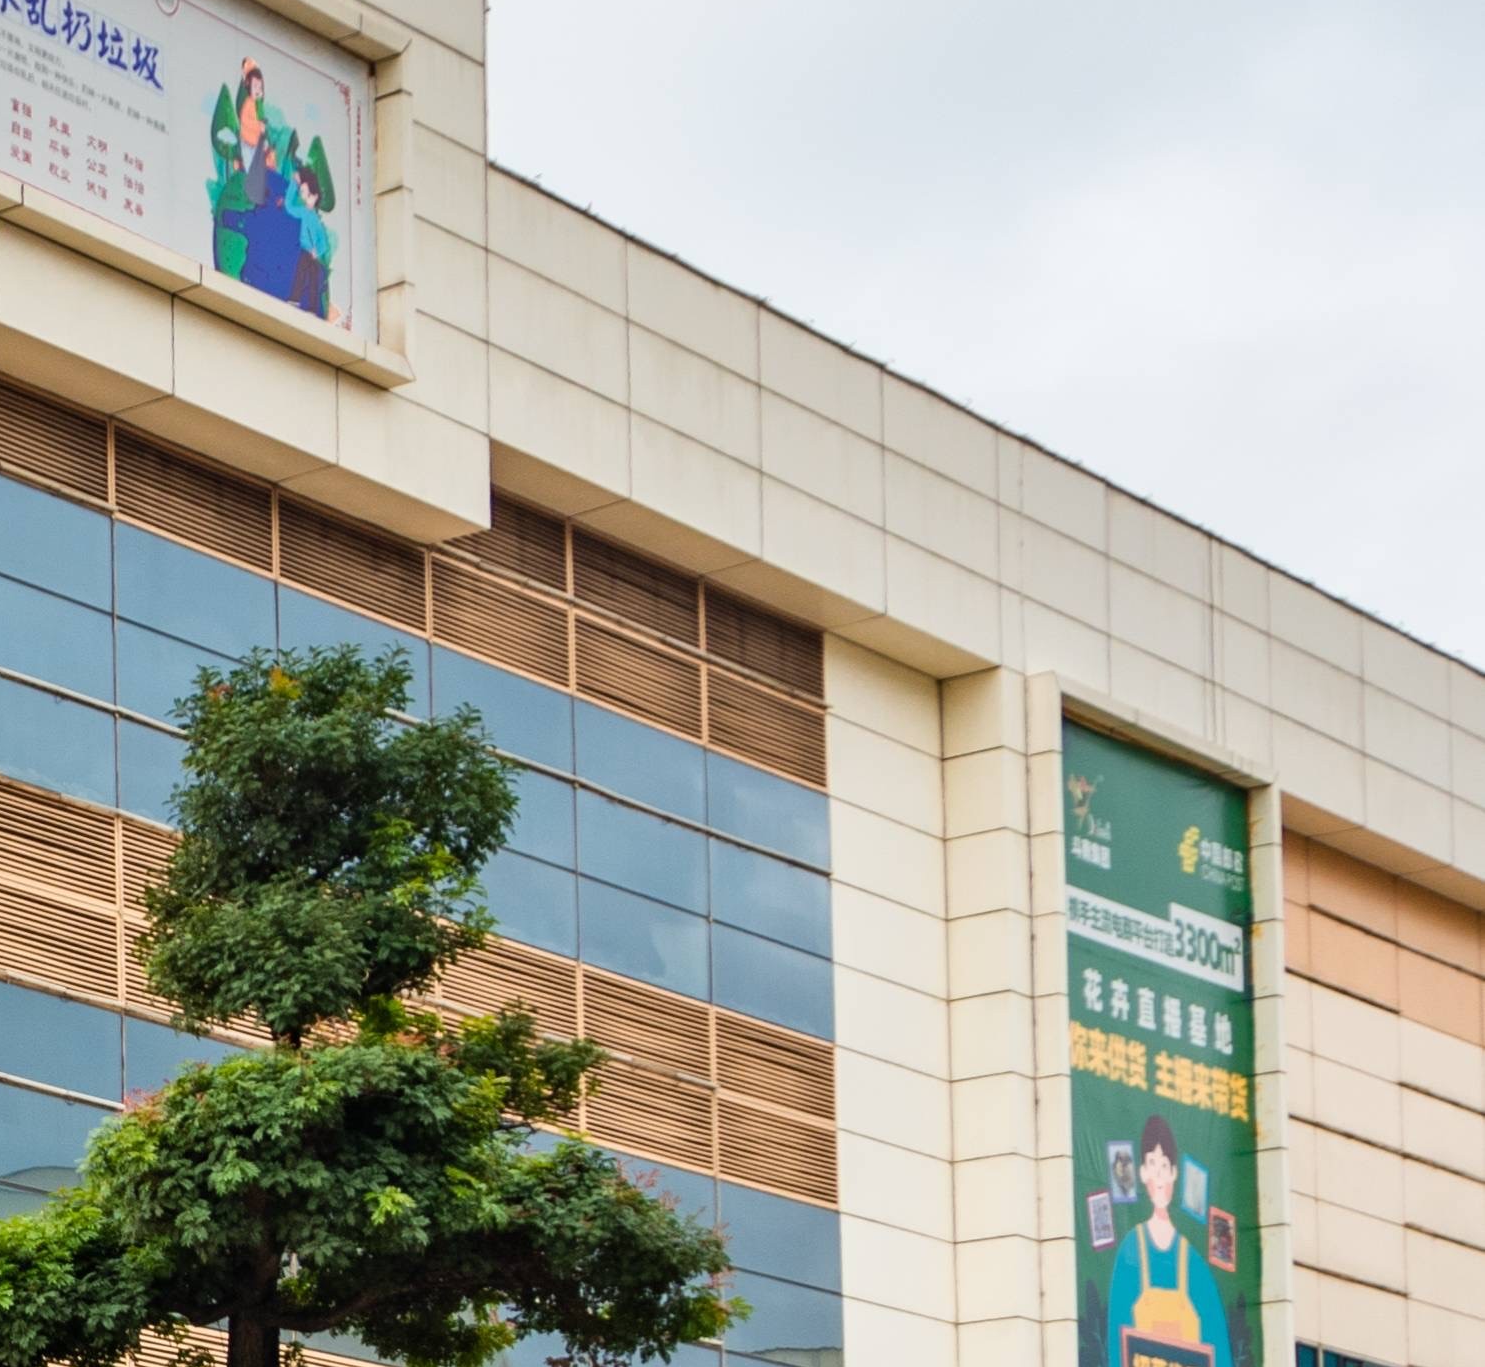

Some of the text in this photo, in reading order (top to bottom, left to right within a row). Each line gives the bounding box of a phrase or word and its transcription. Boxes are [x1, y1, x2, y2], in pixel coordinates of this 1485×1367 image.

[1082, 968, 1234, 1055] 花卉直播基地
